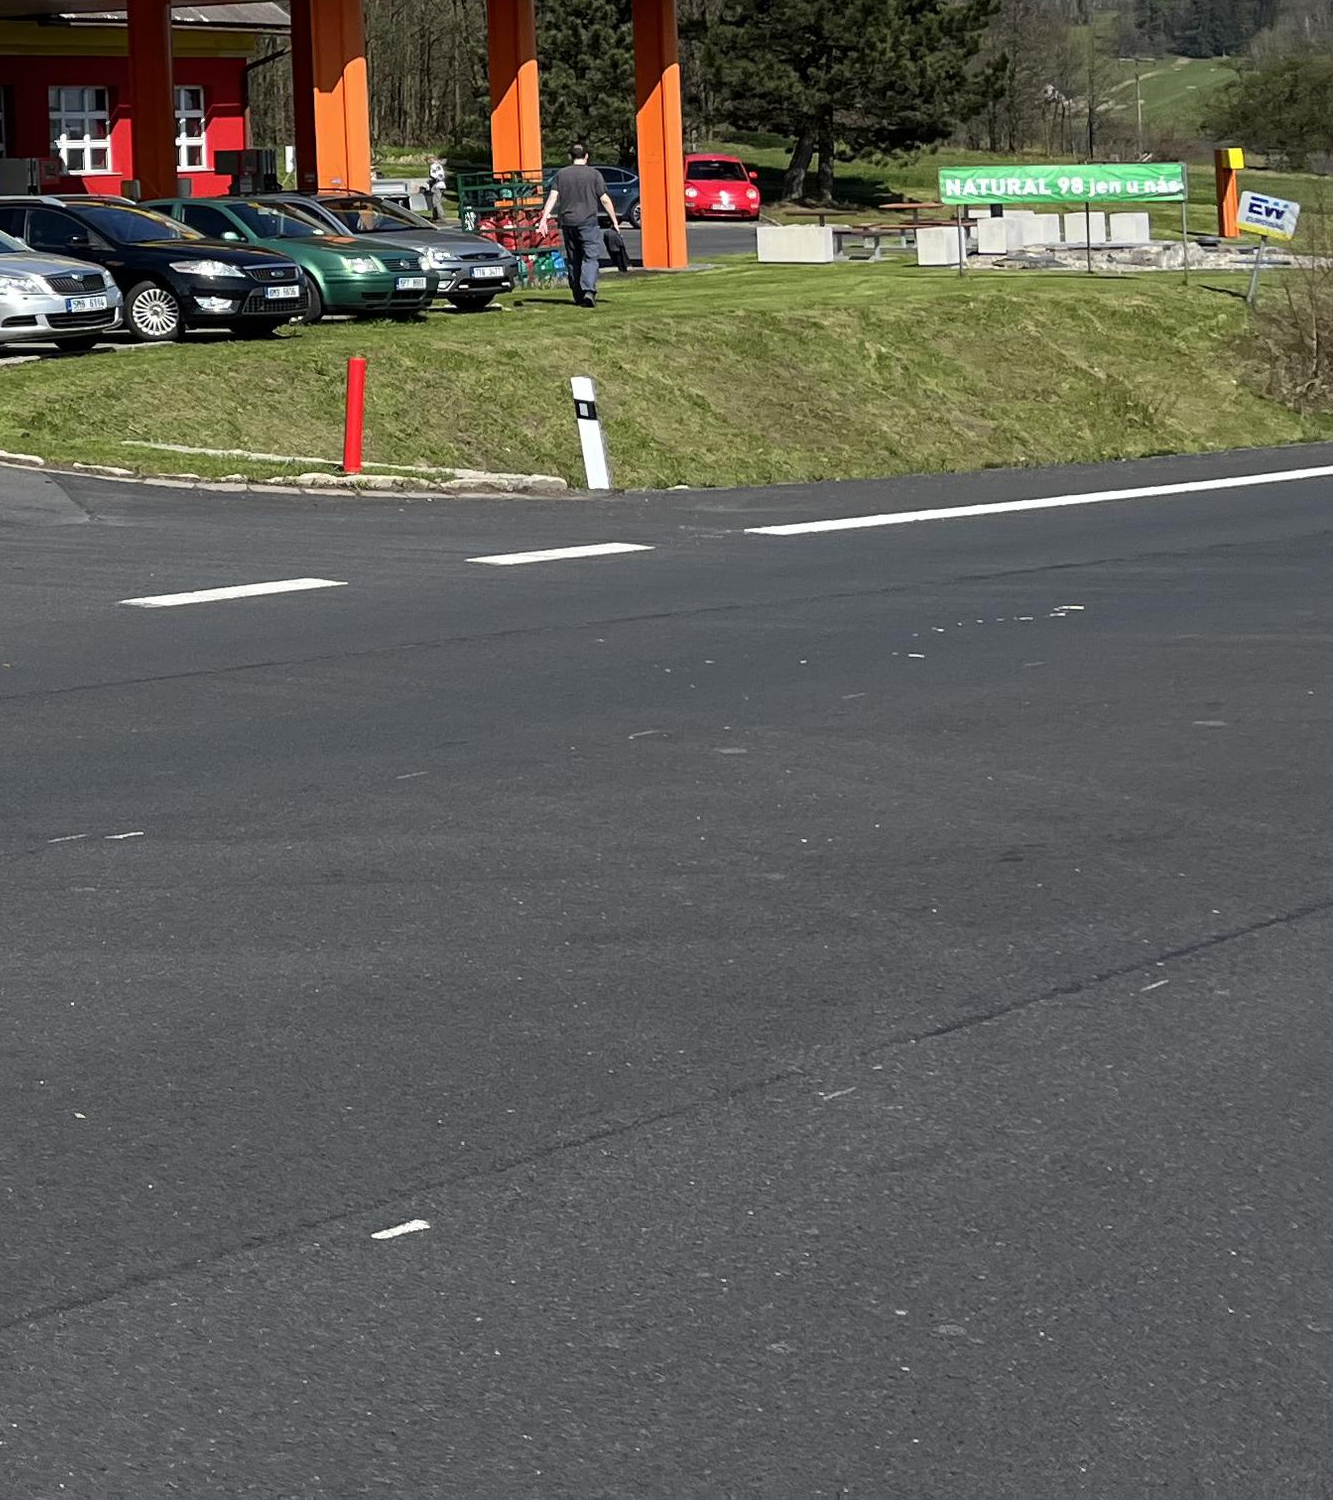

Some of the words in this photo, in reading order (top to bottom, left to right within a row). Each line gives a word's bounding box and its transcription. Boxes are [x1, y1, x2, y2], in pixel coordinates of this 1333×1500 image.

[945, 177, 1052, 198] NATURAL
[1057, 176, 1084, 195] 98
[1088, 178, 1121, 197] jen
[1126, 180, 1139, 194] u
